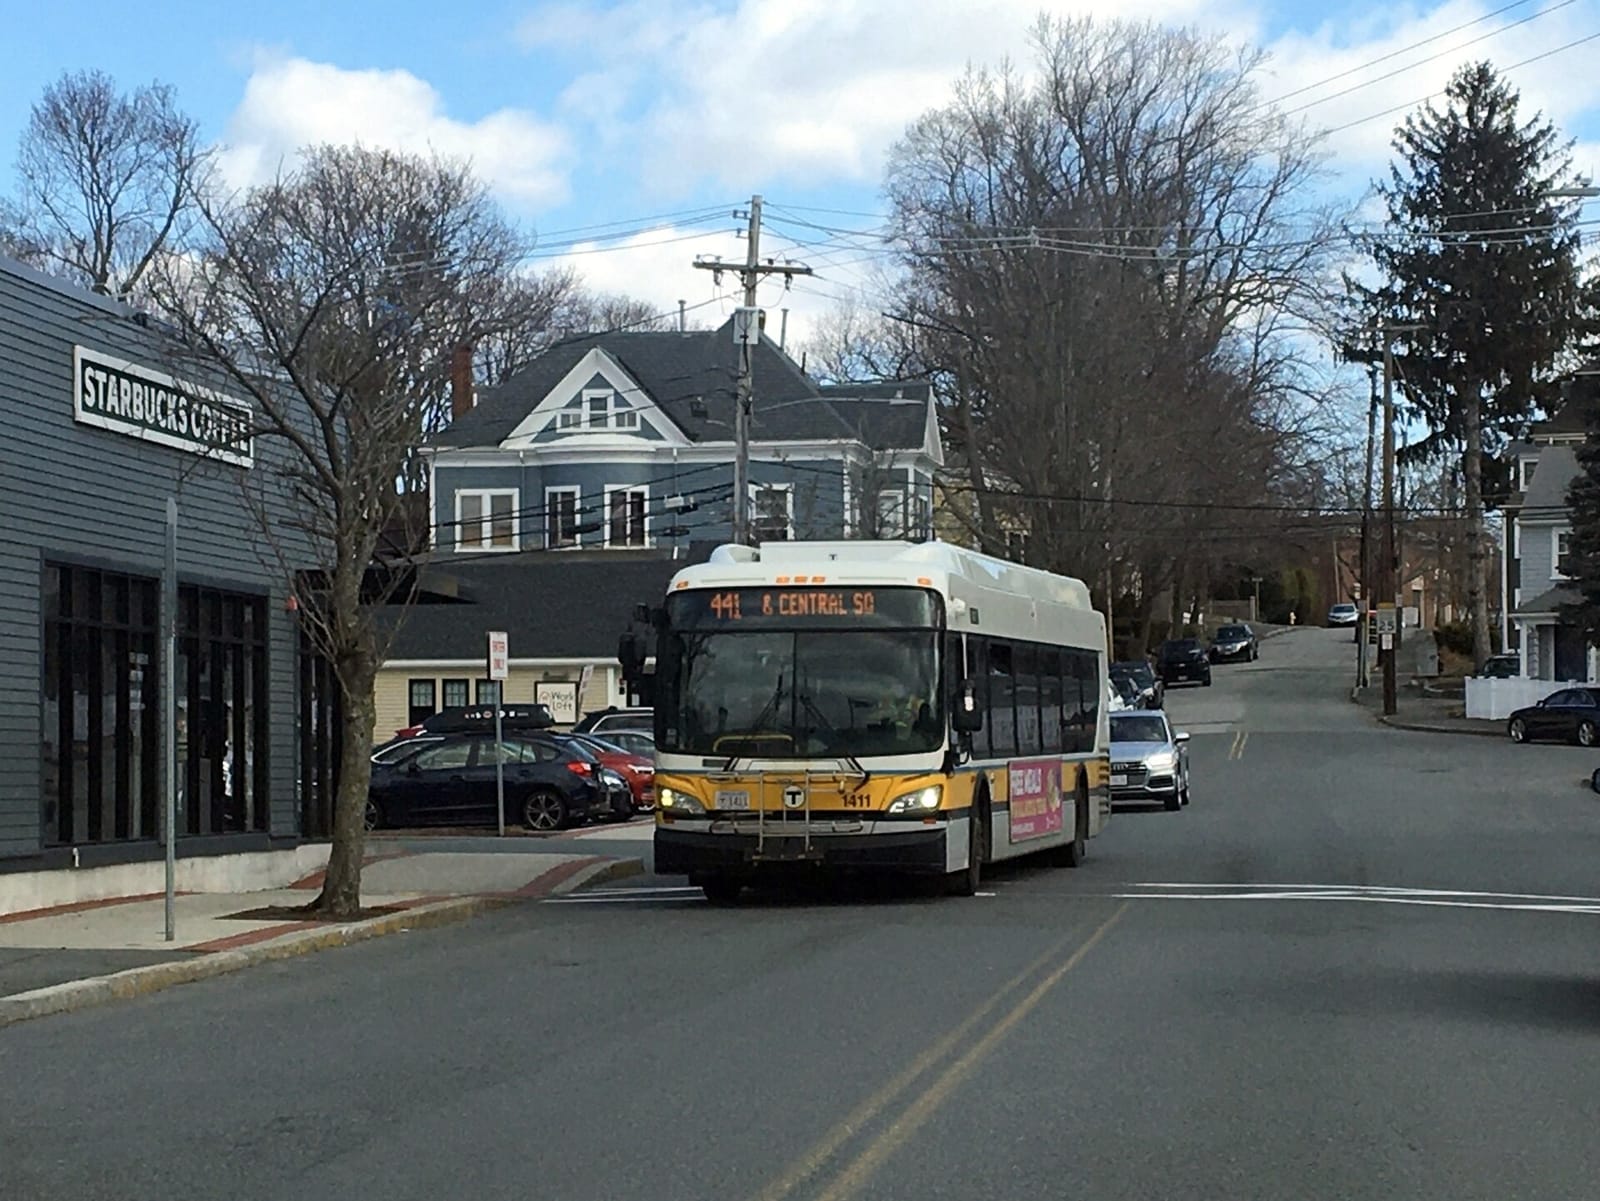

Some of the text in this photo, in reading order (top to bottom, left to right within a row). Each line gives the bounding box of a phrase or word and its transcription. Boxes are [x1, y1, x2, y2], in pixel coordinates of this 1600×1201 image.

[84, 366, 188, 434] STARBUCKS
[710, 593, 743, 620] 441
[779, 593, 848, 615] CENTRAL
[853, 592, 875, 615] SQ
[1379, 620, 1394, 631] 25
[841, 794, 871, 808] 1411
